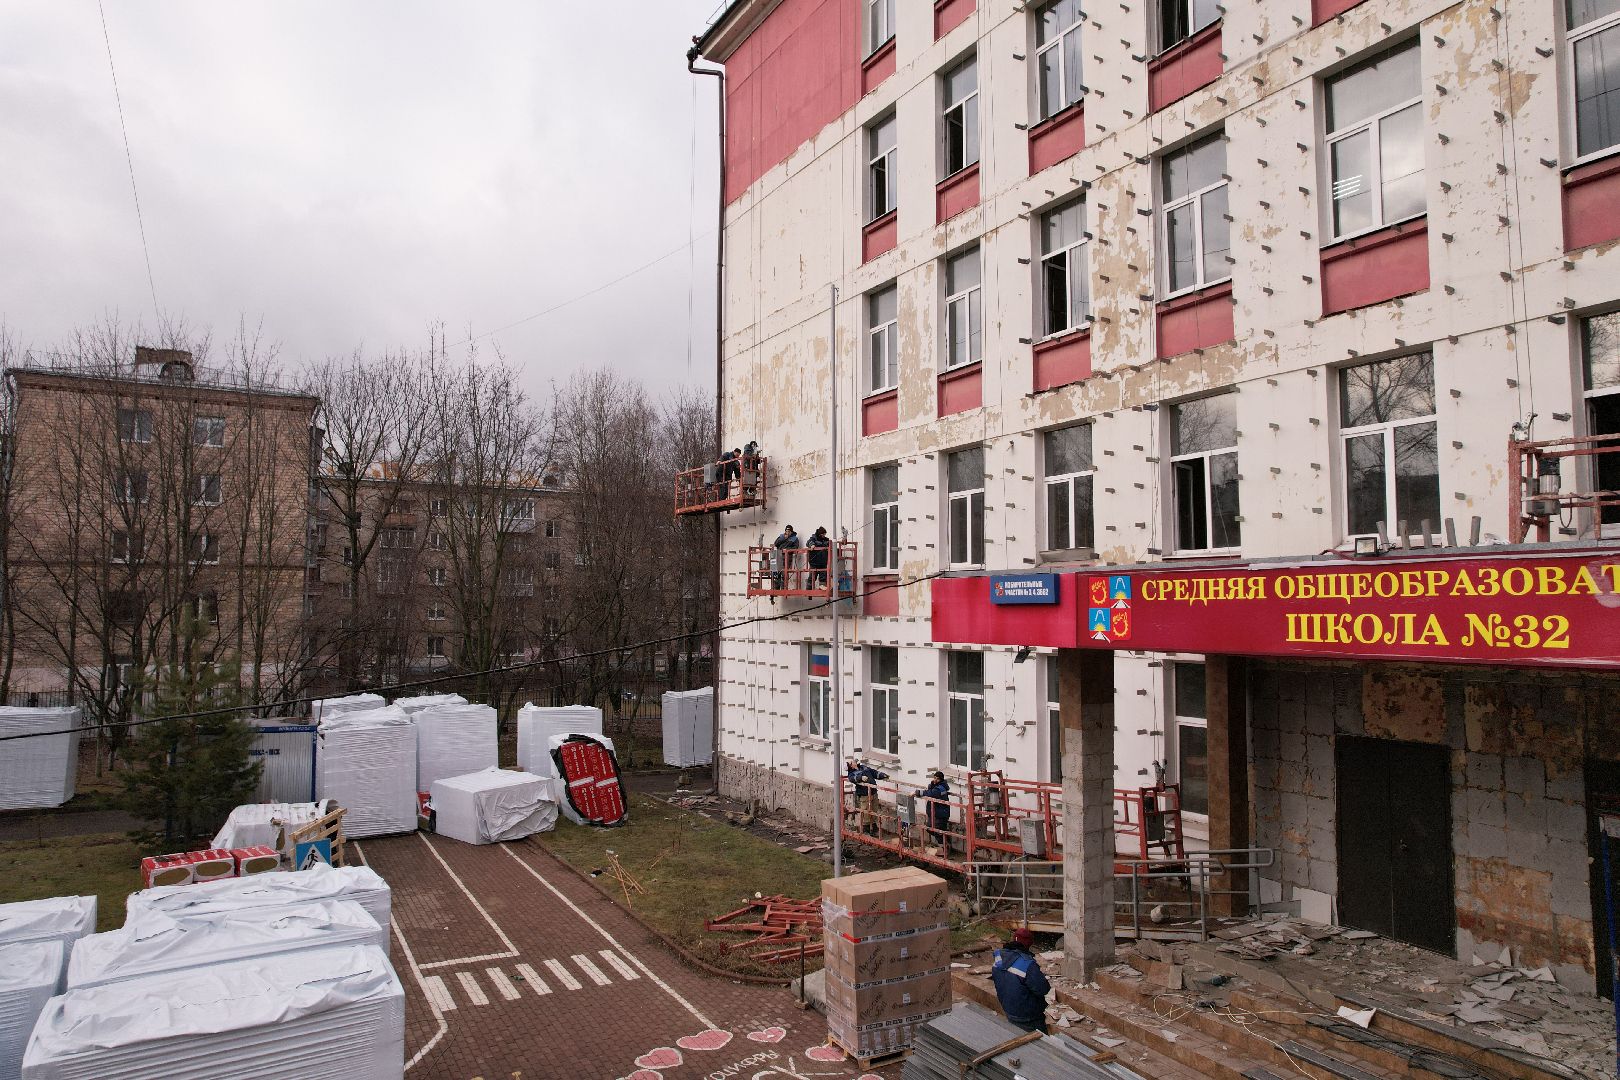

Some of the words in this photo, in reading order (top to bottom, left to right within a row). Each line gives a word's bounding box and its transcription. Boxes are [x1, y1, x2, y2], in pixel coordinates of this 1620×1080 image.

[1141, 576, 1266, 606] СРЕДНЯЯ
[1274, 564, 1620, 605] ОБЩЕОБРАЗОВАТ
[1286, 613, 1450, 646] ШКОЛА
[1461, 613, 1570, 649] №32
